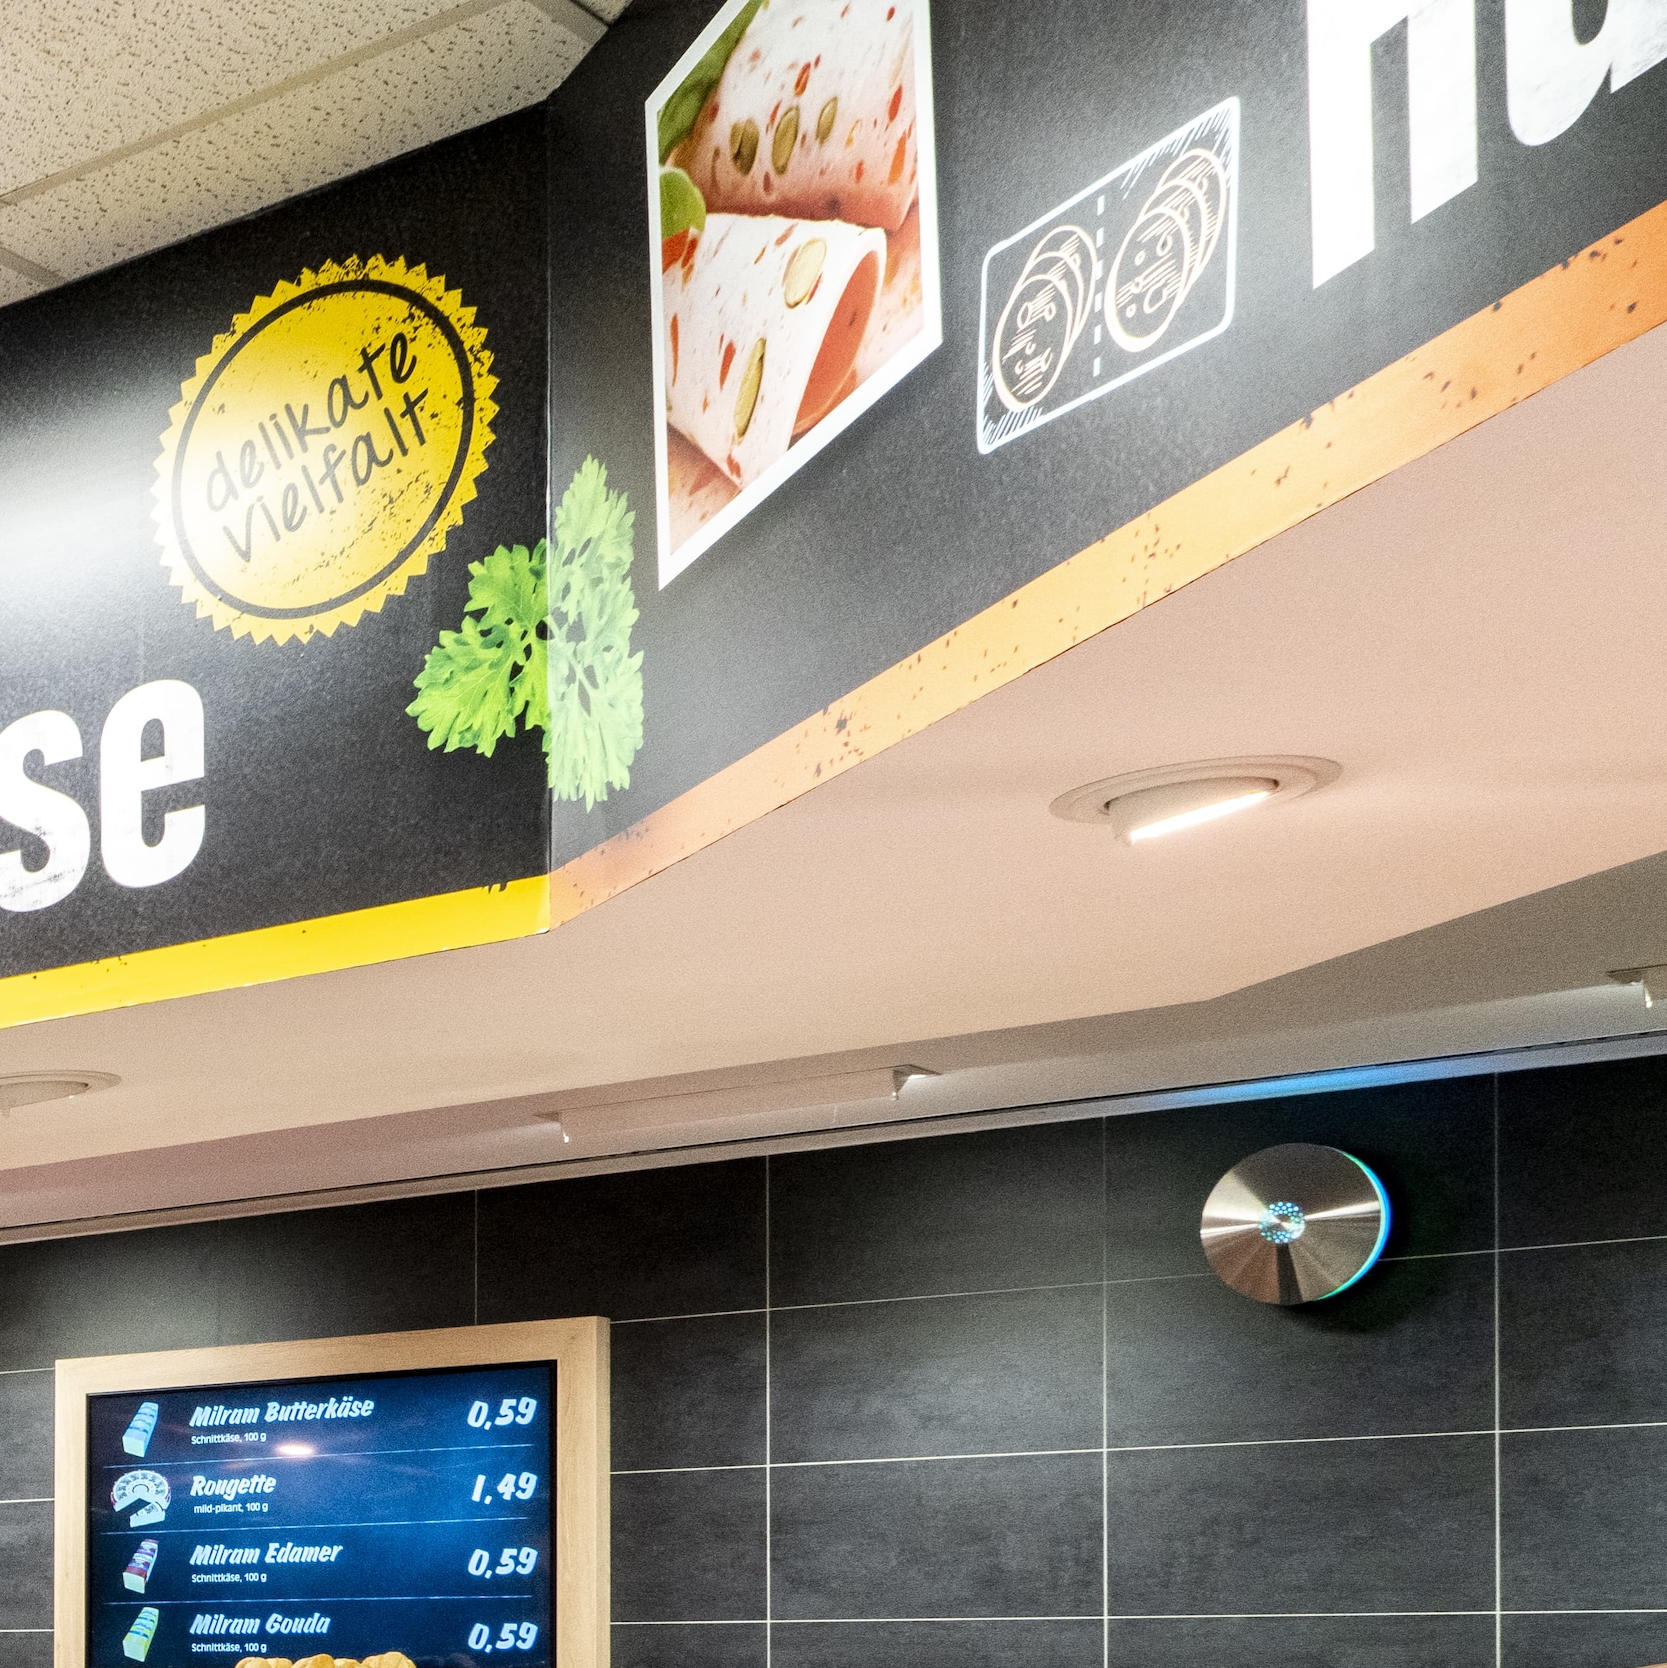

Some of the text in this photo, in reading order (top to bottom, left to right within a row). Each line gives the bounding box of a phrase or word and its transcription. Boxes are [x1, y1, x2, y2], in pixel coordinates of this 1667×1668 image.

[207, 332, 417, 512] delikate
[189, 1396, 537, 1430] Milram Butterkäse 0,59
[191, 1432, 242, 1445] Schnittkäse,
[244, 1431, 258, 1441] 100
[190, 1471, 538, 1505] Rougette 1,49
[246, 1502, 259, 1512] 100
[189, 1542, 538, 1579] Milram Edamer 0,59
[191, 1572, 242, 1584] Schnittkäse,
[244, 1572, 258, 1582] 100
[189, 1612, 538, 1653] Milram Gouda 0,59
[191, 1642, 242, 1654] Schnittkäse,
[244, 1642, 258, 1652] 100
